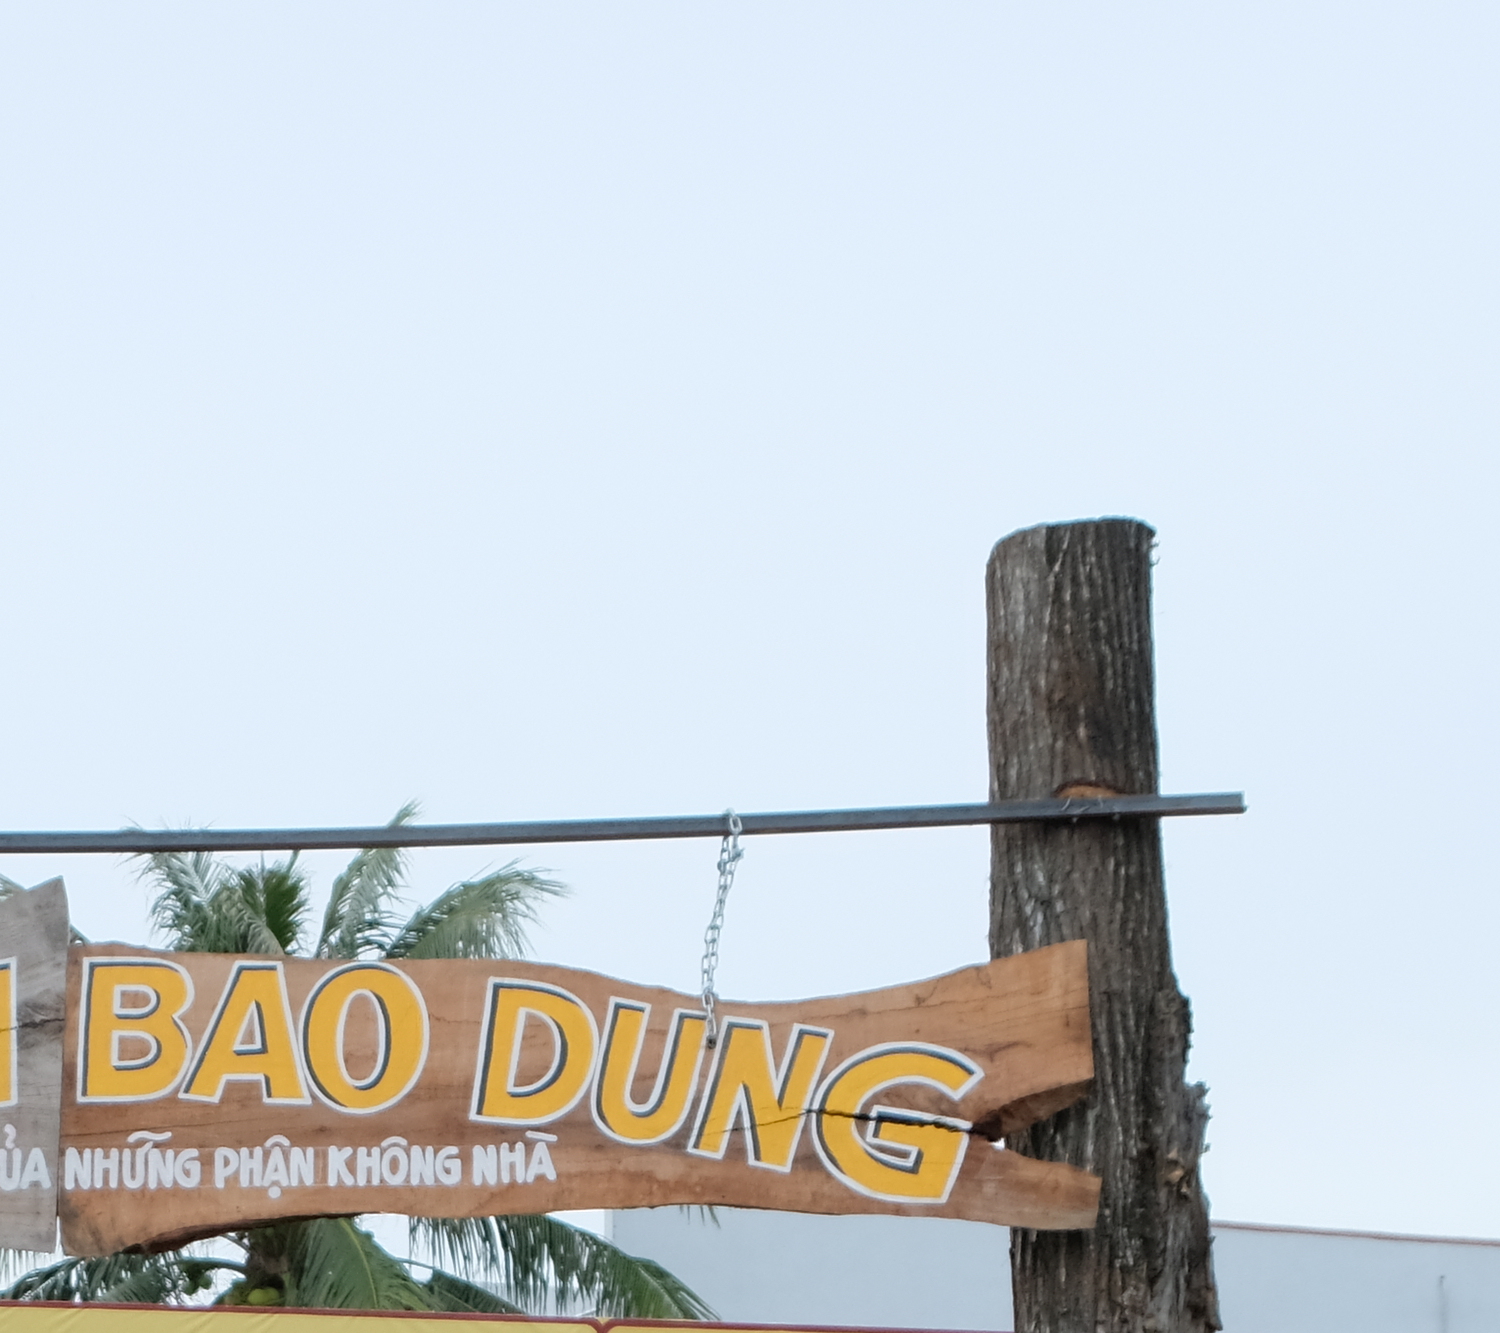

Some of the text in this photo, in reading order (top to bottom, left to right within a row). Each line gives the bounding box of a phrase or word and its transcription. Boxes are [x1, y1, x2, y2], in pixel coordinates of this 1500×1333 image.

[76, 956, 429, 1114] BAO
[469, 976, 985, 1204] DUNG
[64, 1130, 200, 1190] NHỮNG
[214, 1134, 315, 1199] PHẬN
[328, 1136, 461, 1187] KHÔNG
[472, 1131, 558, 1185] NHÀ
